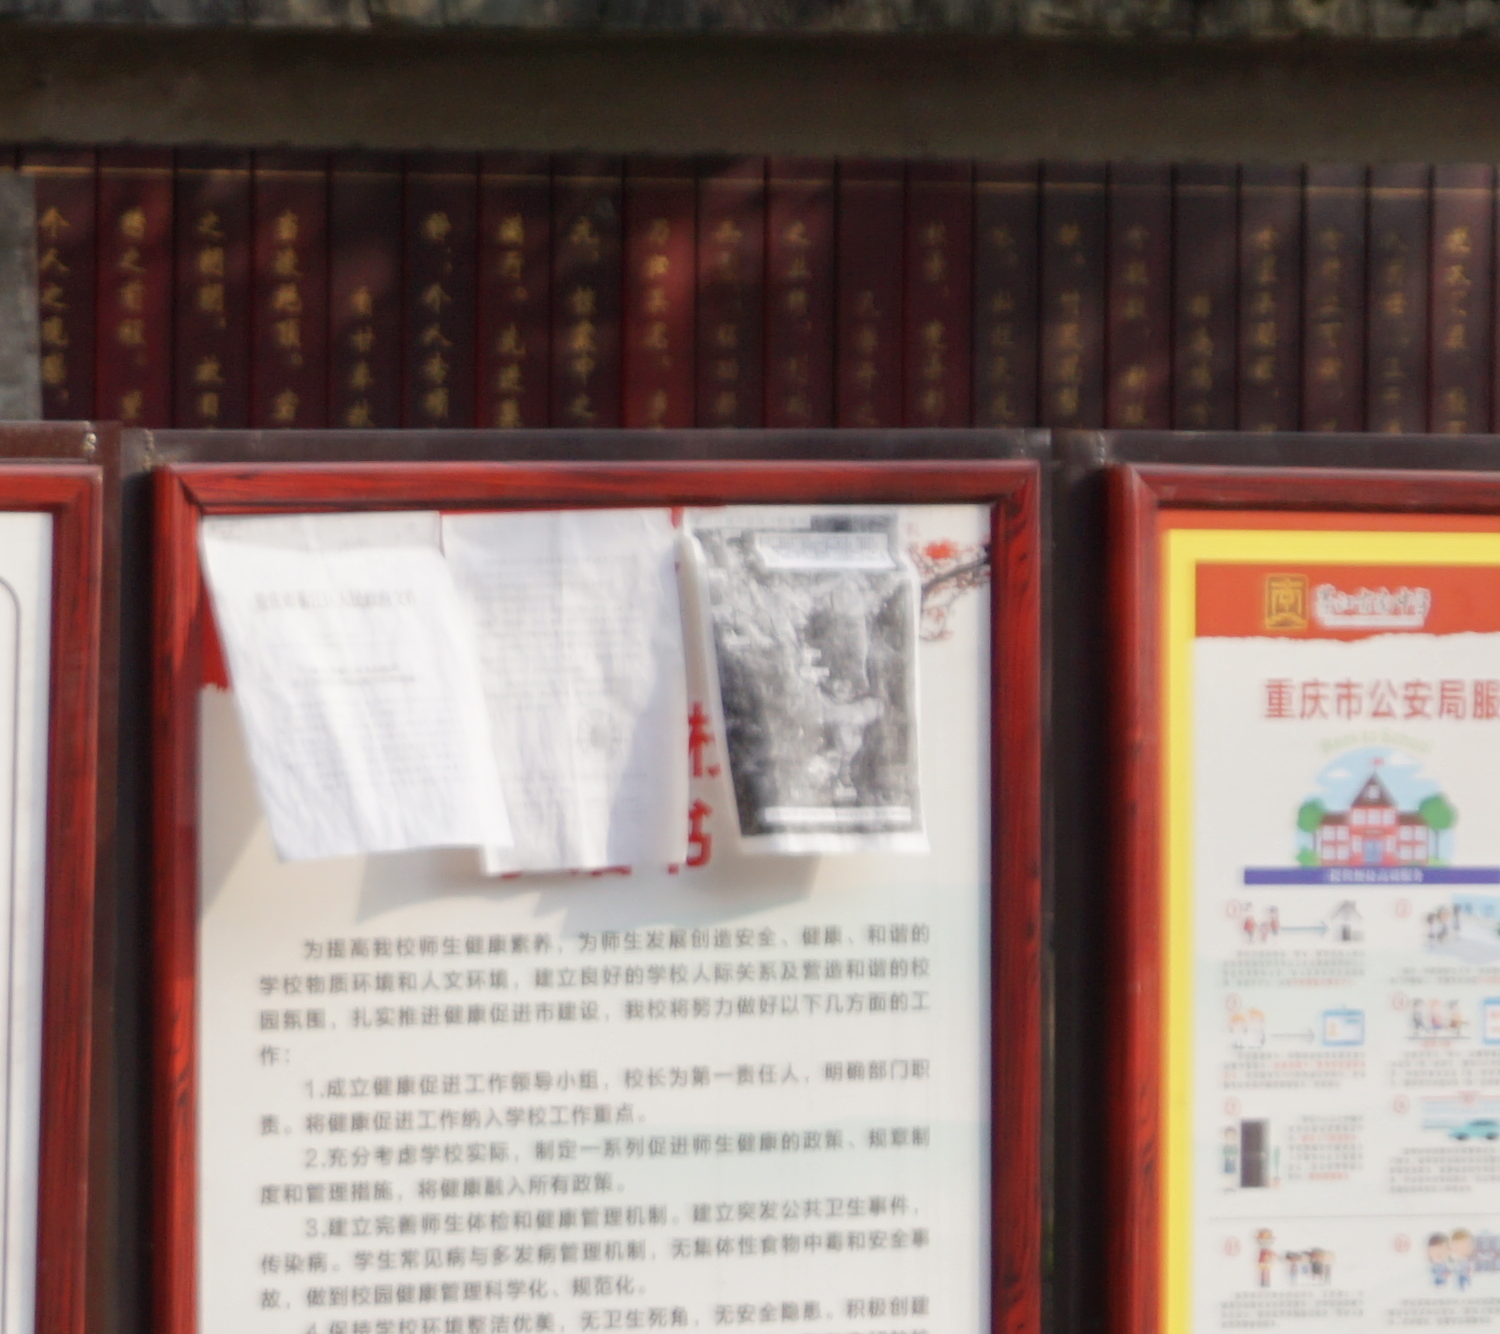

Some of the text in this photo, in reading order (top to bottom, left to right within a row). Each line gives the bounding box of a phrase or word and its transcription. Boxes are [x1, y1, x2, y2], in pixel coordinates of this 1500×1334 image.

[1263, 677, 1500, 720] 重庆市公安局服
